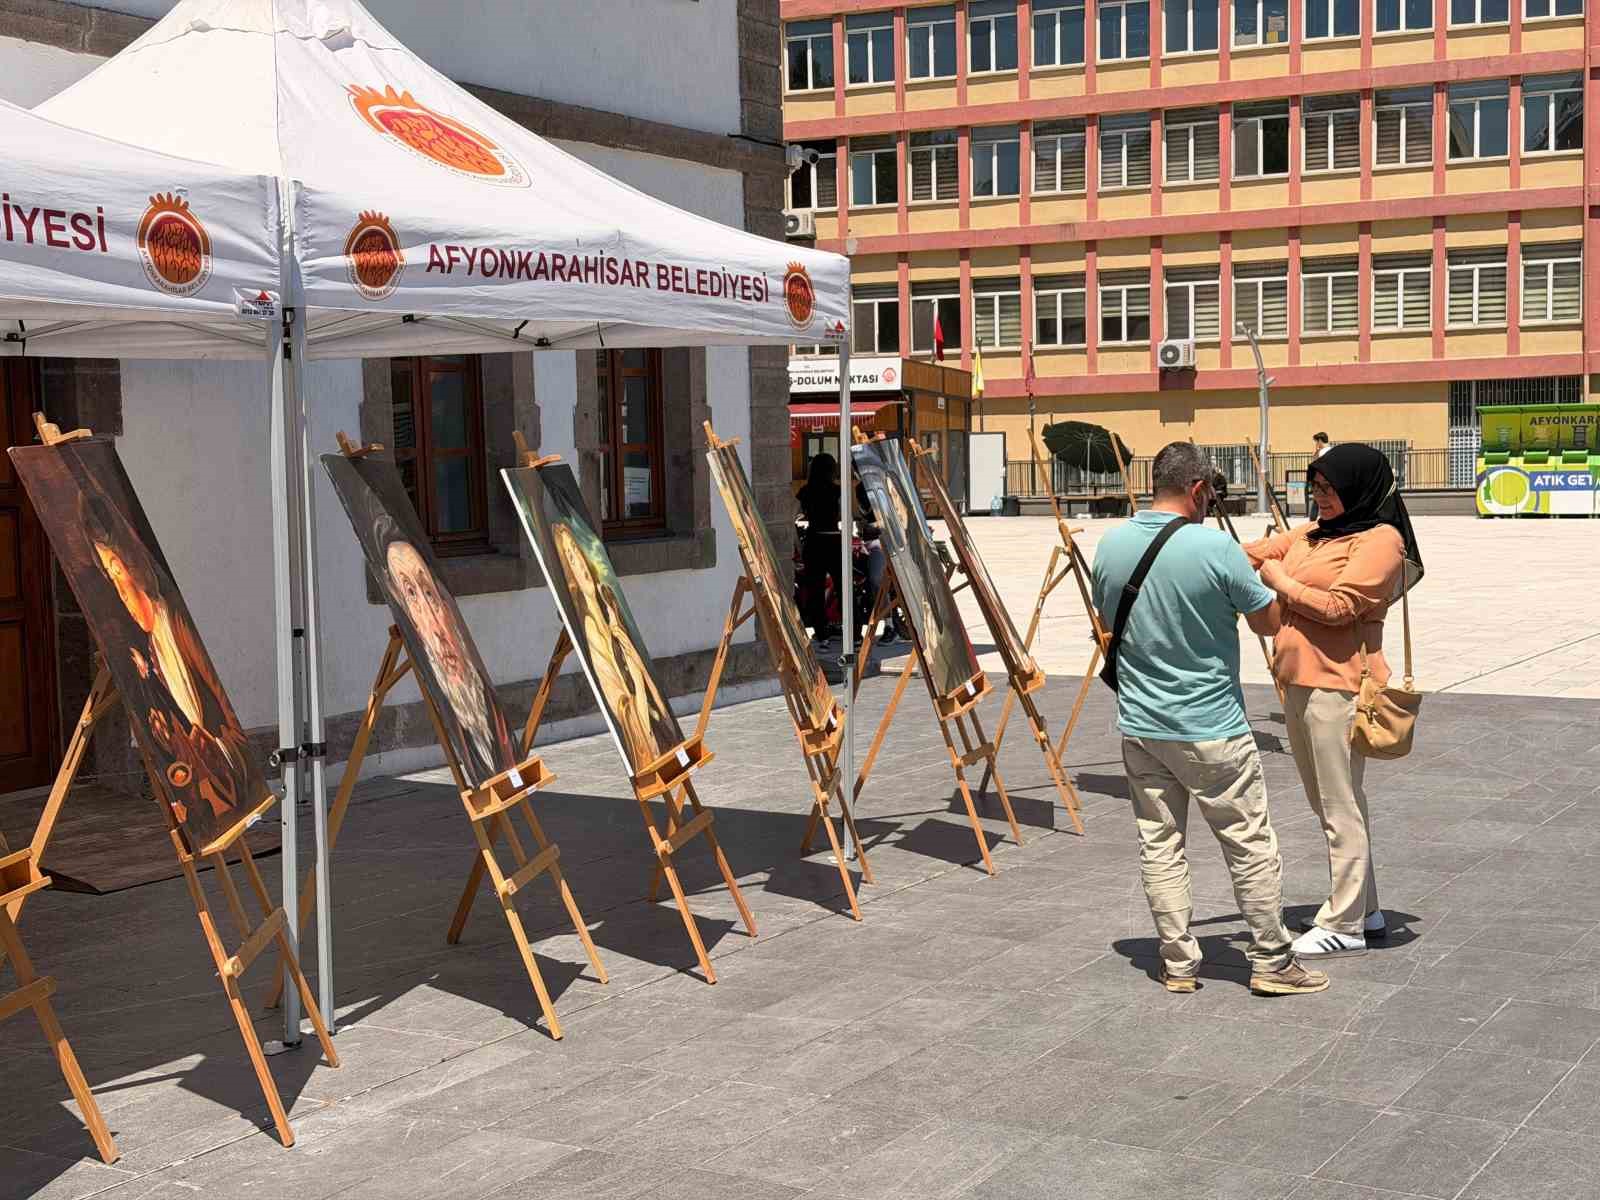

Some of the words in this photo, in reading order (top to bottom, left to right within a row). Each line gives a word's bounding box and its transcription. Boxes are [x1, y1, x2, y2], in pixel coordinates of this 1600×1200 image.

[0, 193, 108, 252] İYESİ
[426, 244, 650, 289] AFYONKARAHİSAR
[656, 263, 769, 302] BELEDİYESİ
[835, 374, 878, 384] NKTASI
[1534, 474, 1565, 486] ATIK
[1567, 474, 1597, 486] GET
